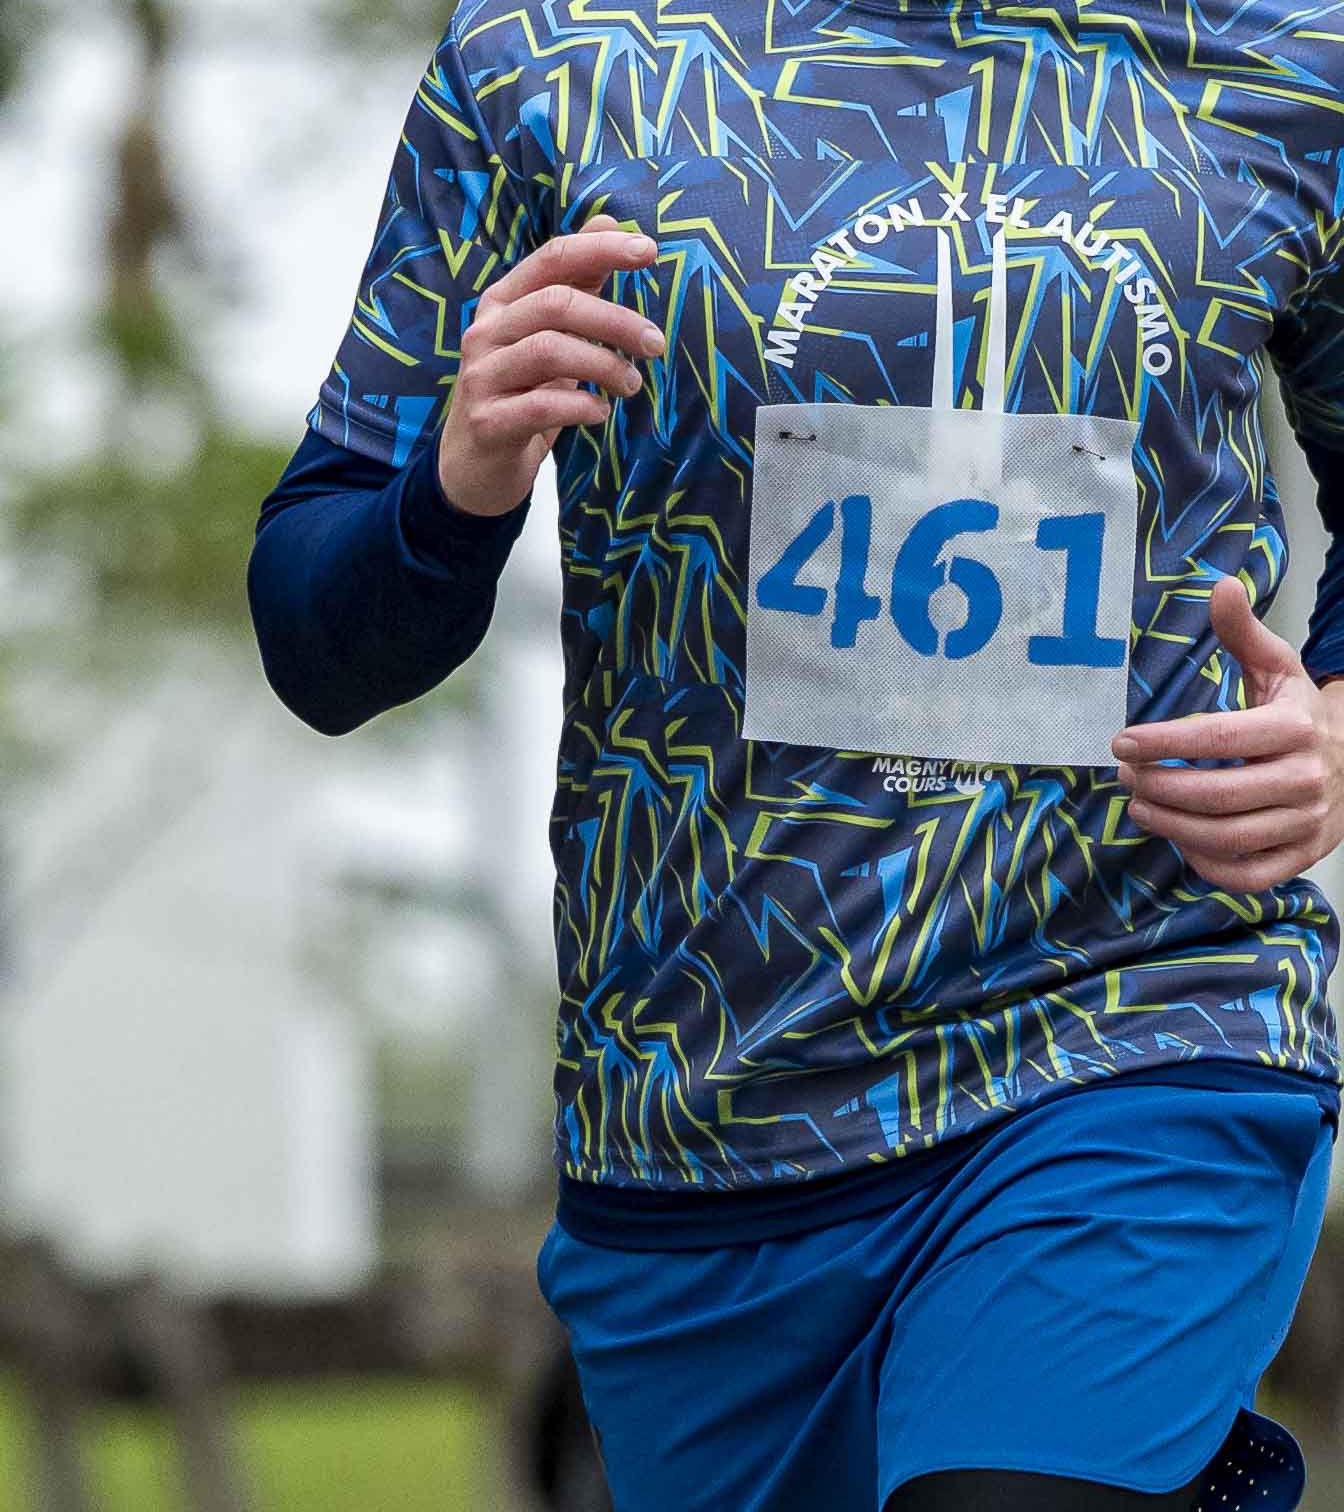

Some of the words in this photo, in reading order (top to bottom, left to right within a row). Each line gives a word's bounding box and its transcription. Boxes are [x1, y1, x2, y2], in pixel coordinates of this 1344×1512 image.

[763, 197, 924, 369] MARATÓN
[938, 192, 971, 222] X
[985, 193, 1030, 229] EL
[1040, 210, 1173, 377] AUTISMO
[756, 494, 1128, 668] 461
[872, 757, 950, 776] MAGNY
[882, 775, 947, 793] COURS
